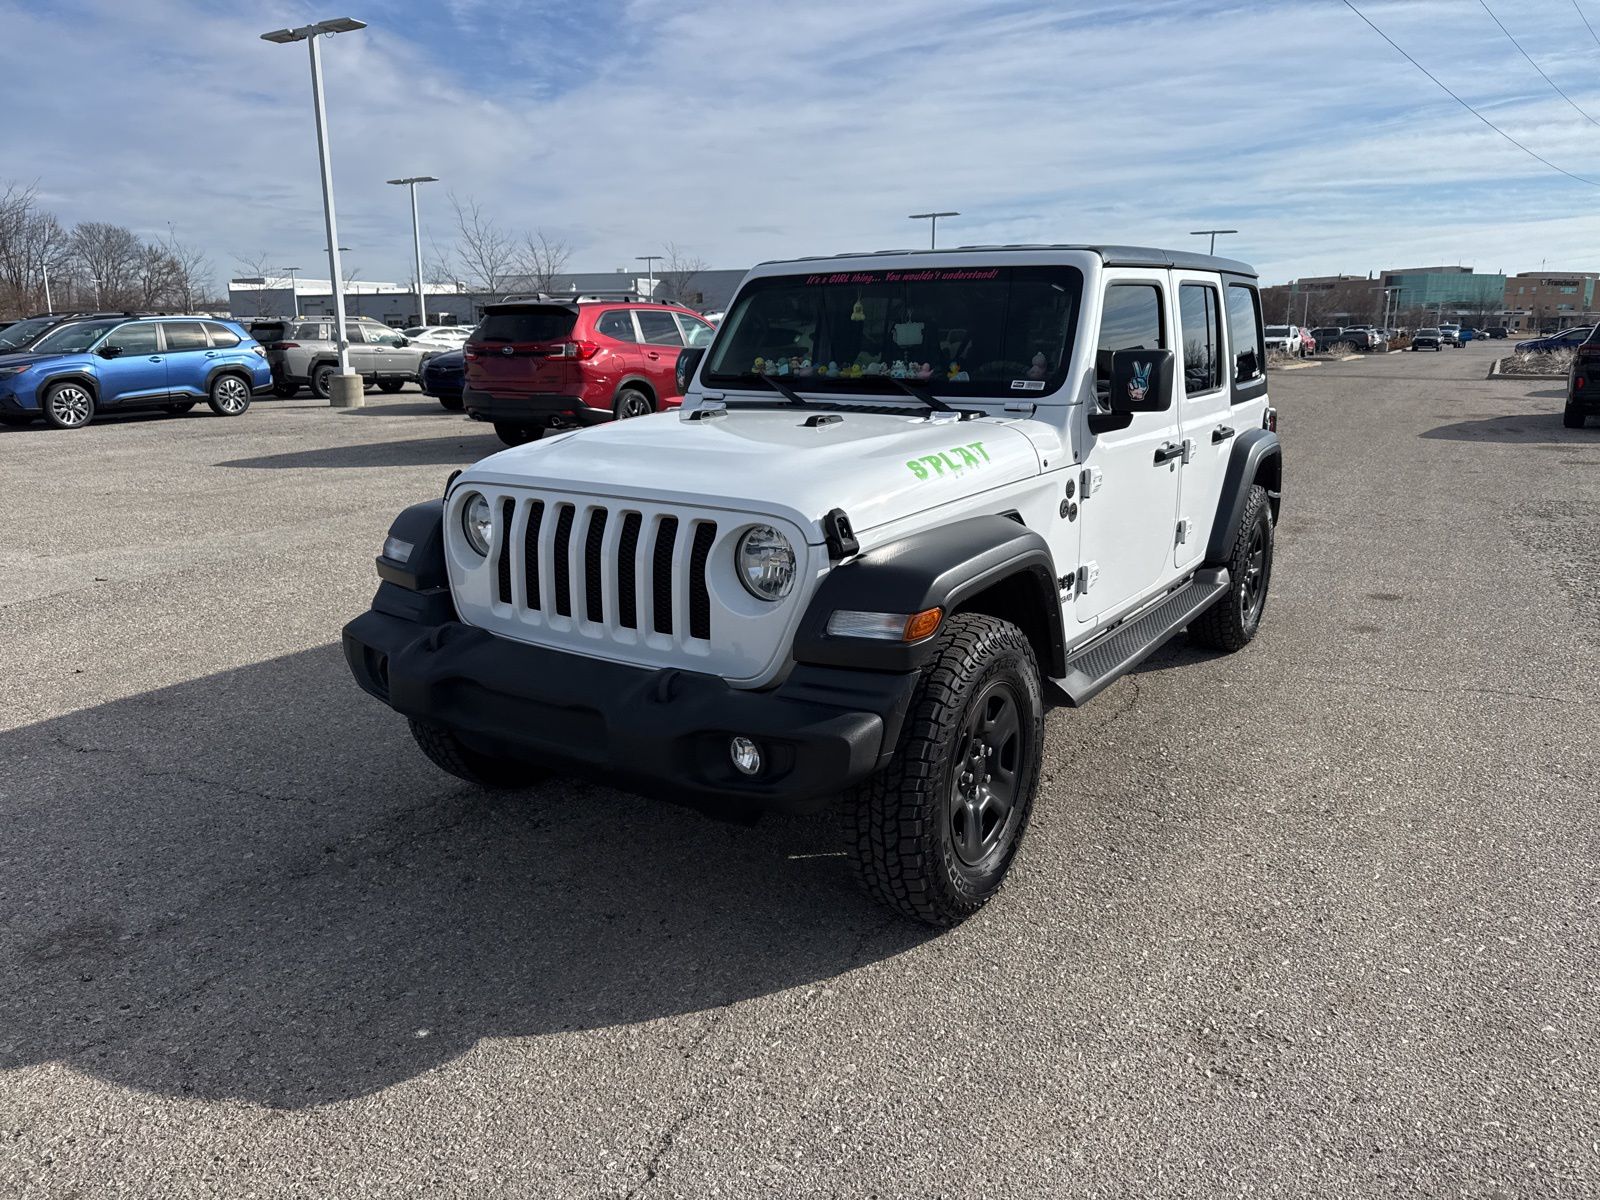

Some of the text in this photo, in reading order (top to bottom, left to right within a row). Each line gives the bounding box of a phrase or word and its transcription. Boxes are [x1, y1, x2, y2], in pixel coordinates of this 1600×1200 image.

[806, 275, 820, 285] It's
[828, 274, 849, 284] GIRL
[886, 272, 900, 281] You
[902, 270, 940, 281] wouldn't
[941, 268, 999, 280] understand!
[906, 441, 990, 480] SPLAT
